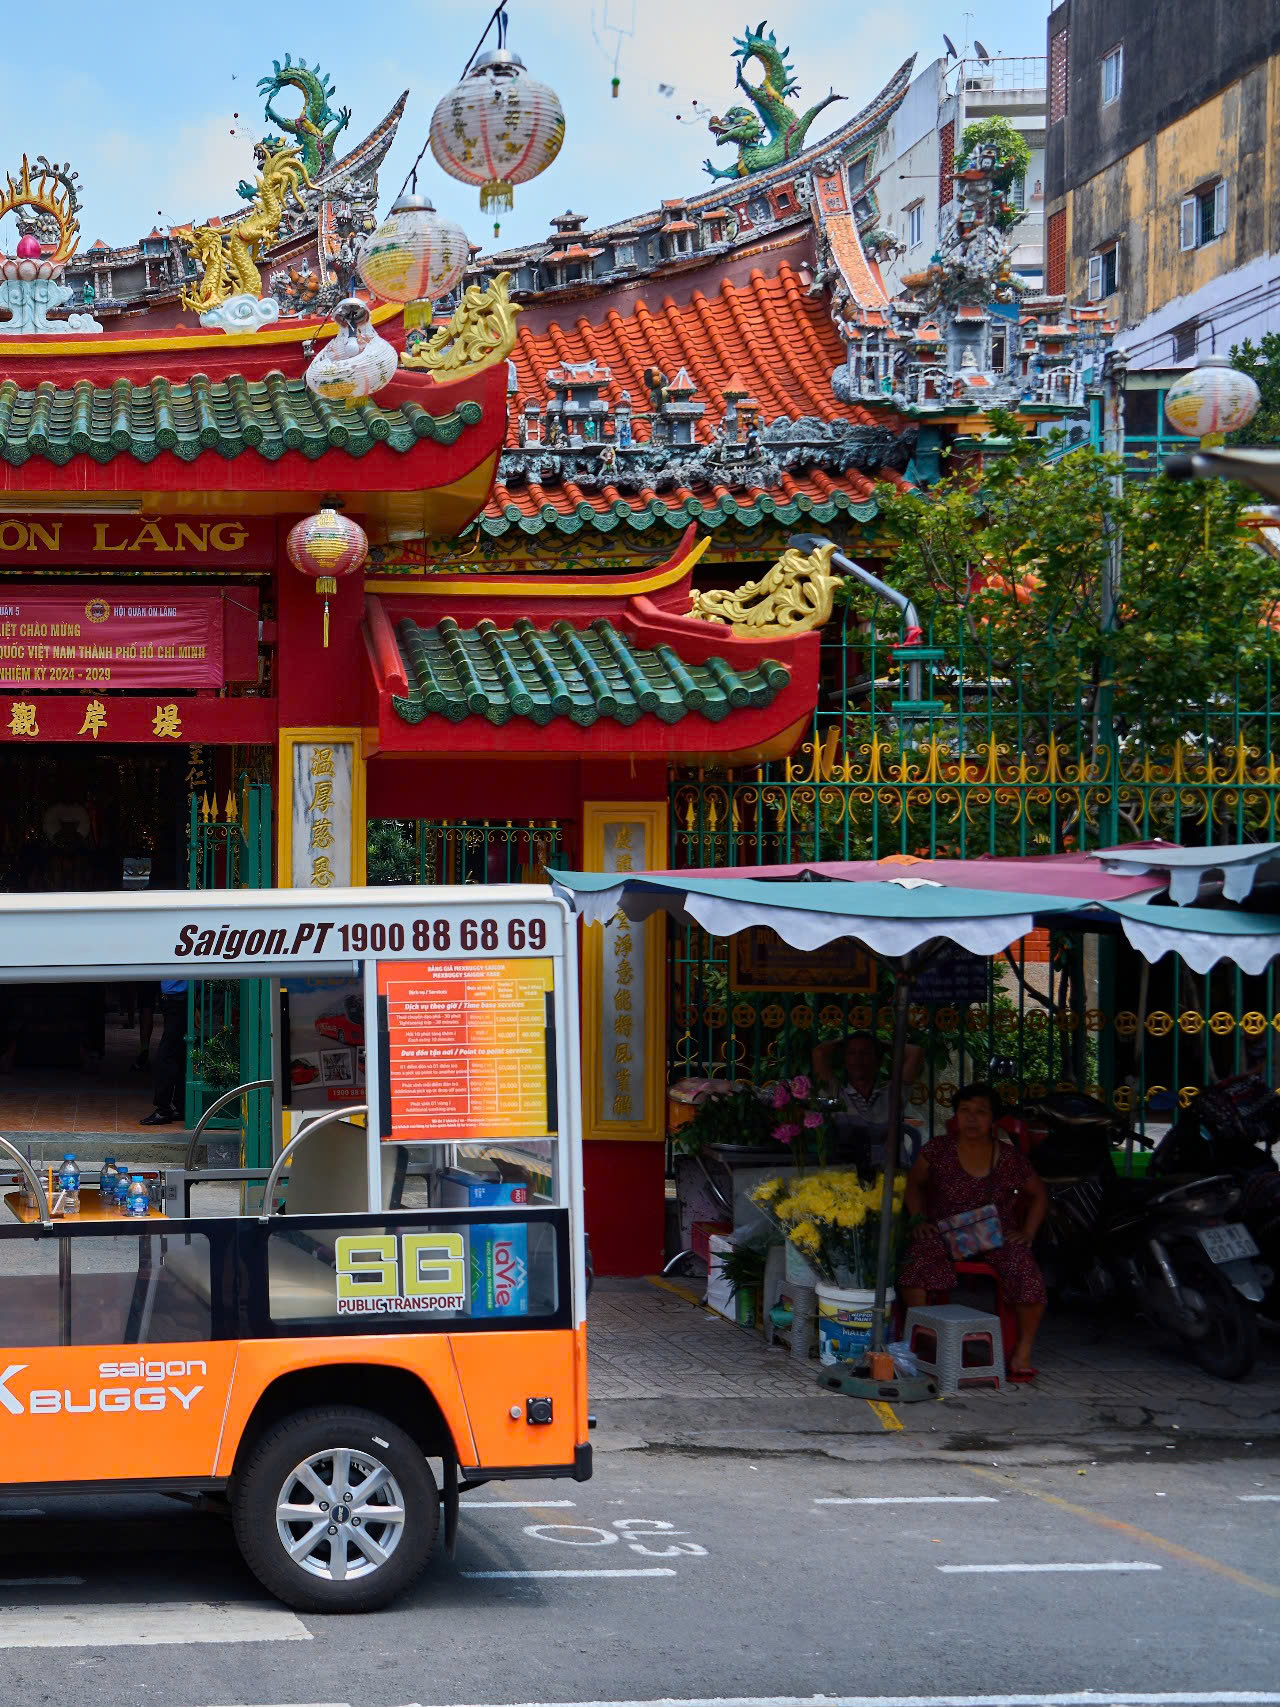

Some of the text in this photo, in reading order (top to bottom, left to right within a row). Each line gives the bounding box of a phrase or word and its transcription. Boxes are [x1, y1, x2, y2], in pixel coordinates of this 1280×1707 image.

[92, 516, 250, 551] LĂNG
[15, 606, 20, 616] 5
[114, 606, 127, 618] HỘI
[20, 621, 48, 637] CHÀO
[50, 621, 81, 637] MỪNG
[27, 643, 49, 661] VIỆT
[53, 646, 76, 658] NAM
[78, 643, 113, 658] THÀNH
[115, 641, 138, 658] PHỐ
[139, 641, 154, 658] HỒ
[157, 642, 175, 658] CHÍ
[178, 646, 207, 659] MINH
[34, 665, 47, 681] KỲ
[50, 667, 75, 681] 2024
[85, 667, 111, 681] 2029
[174, 918, 547, 960] Saigon.PT 1900 88 68 69
[405, 1003, 420, 1011] Dịch
[446, 1002, 458, 1011] giờ
[497, 1001, 525, 1009] services
[459, 1048, 477, 1056] Point
[486, 1047, 505, 1056] point
[335, 1233, 465, 1298] SG
[338, 1296, 464, 1312] PUBLIC TRANSPORT
[842, 1327, 872, 1337] MATEX
[99, 1356, 207, 1381] saigon
[29, 1385, 205, 1414] BUGGY
